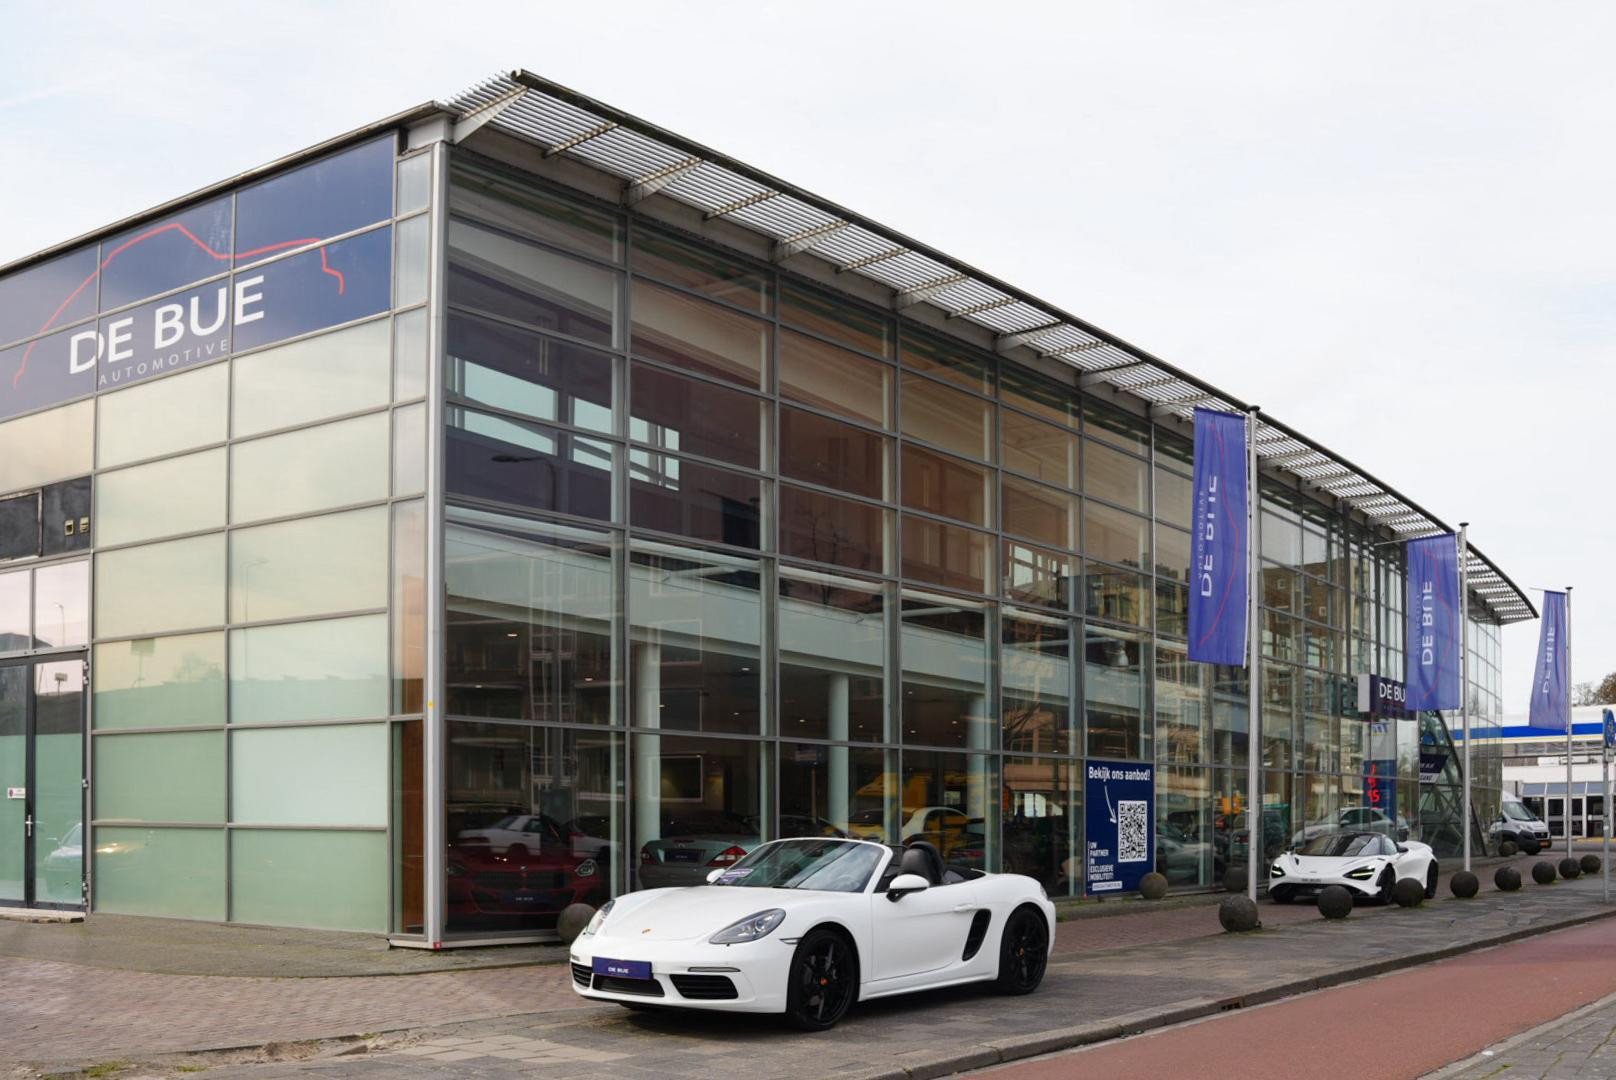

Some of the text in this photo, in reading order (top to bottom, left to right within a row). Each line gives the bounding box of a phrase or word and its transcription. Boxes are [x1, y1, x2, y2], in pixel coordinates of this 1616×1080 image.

[69, 275, 265, 375] DE BUE
[99, 338, 229, 386] AUTOMOTIVE
[1379, 682, 1406, 702] DE BU
[1088, 766, 1151, 782] Bekijk ons aanbod!
